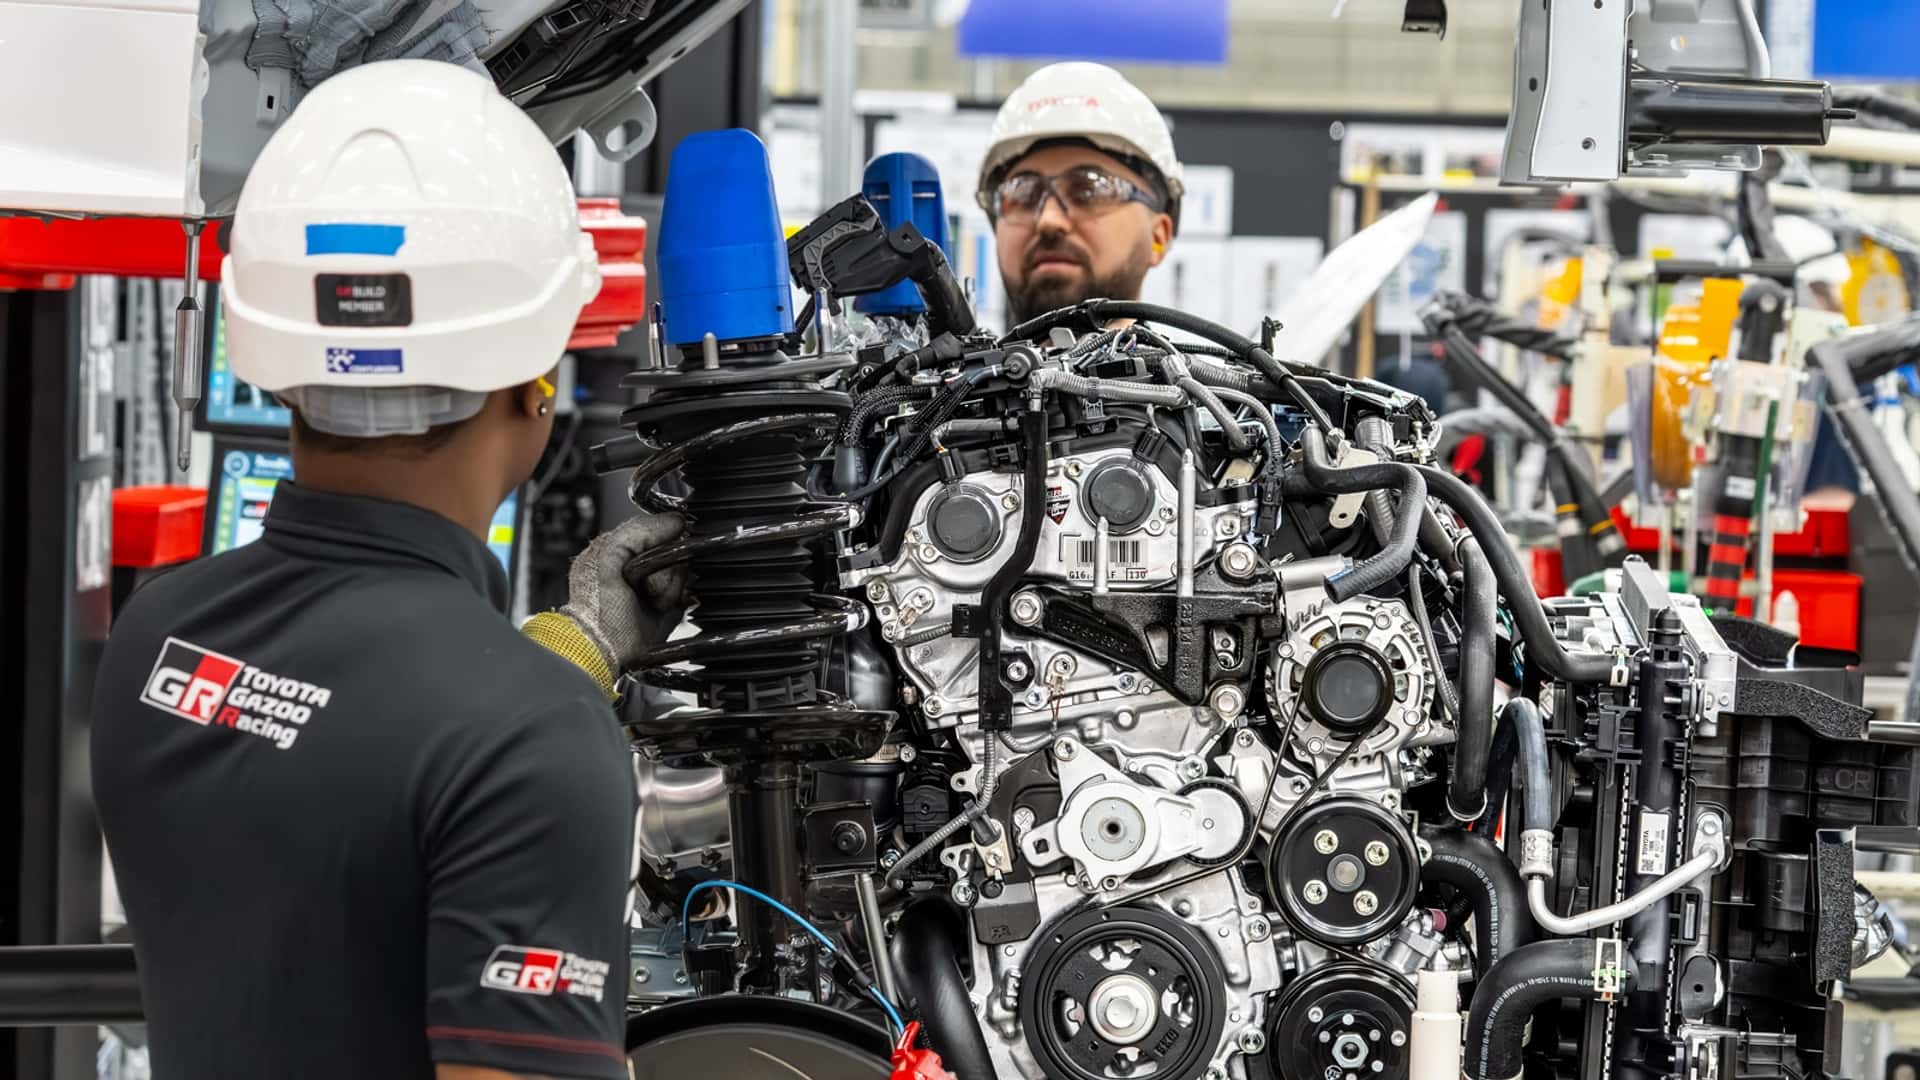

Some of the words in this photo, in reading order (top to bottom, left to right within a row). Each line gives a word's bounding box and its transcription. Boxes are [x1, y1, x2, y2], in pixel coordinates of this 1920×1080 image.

[1026, 96, 1102, 112] TOYA
[148, 666, 225, 719] GR
[227, 686, 312, 724] GAZOO
[241, 665, 331, 708] TOYOTA
[216, 705, 299, 749] Racing
[487, 960, 554, 991] GR
